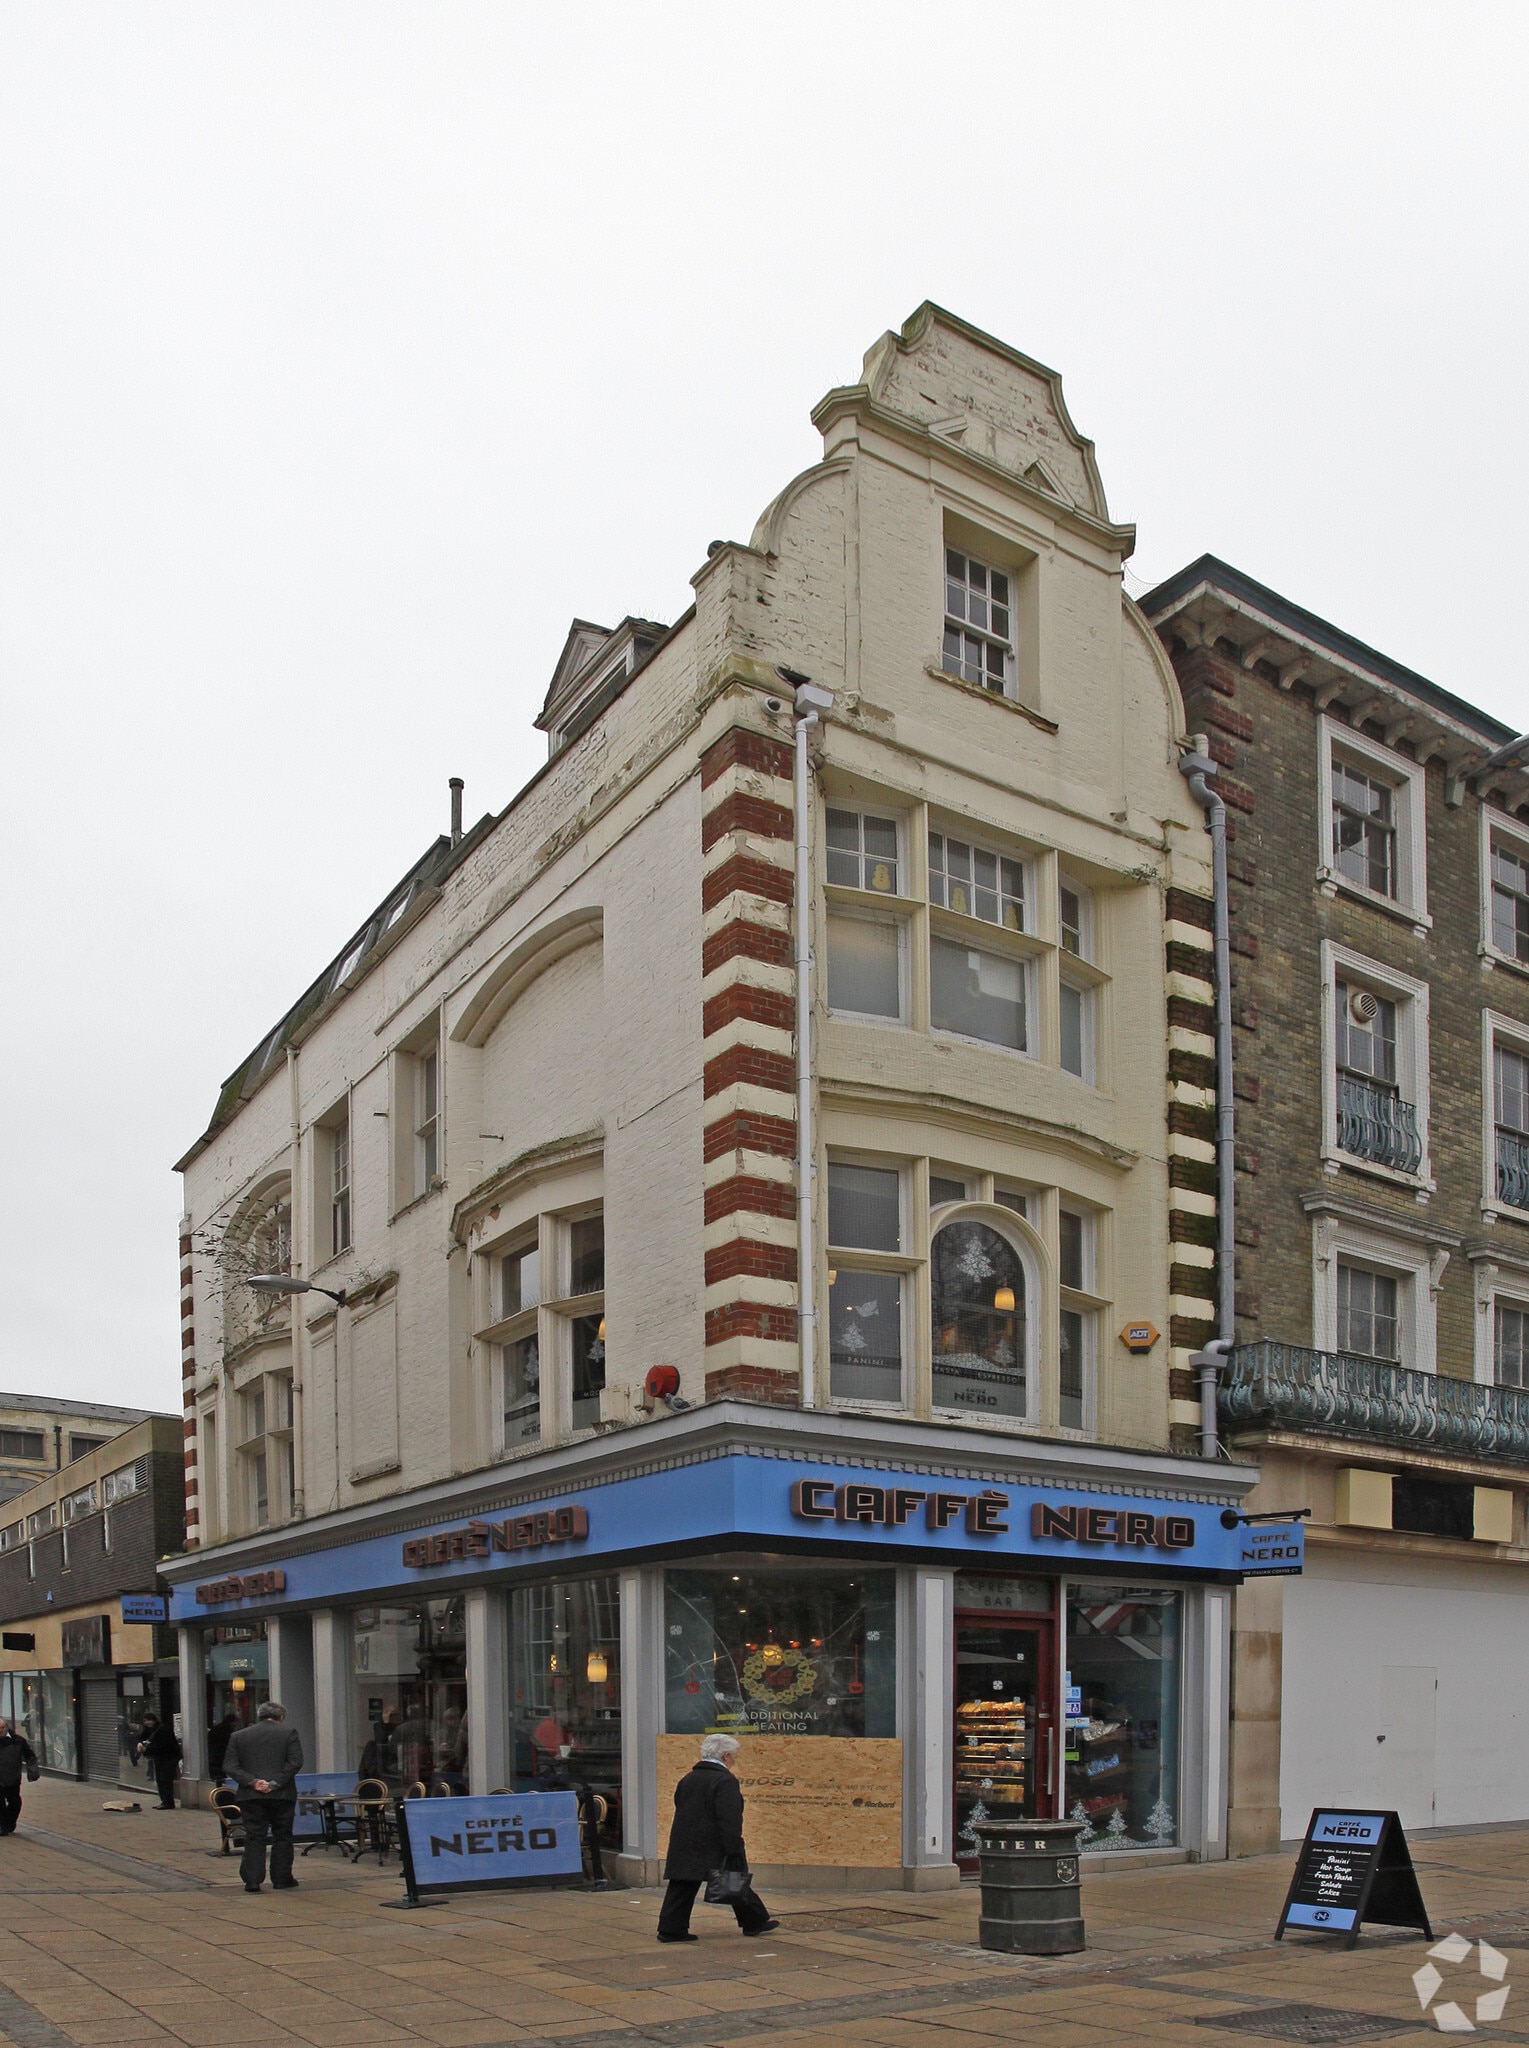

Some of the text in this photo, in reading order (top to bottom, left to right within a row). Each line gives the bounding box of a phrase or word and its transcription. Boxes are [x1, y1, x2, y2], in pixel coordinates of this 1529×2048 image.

[1130, 1330, 1149, 1338] ADT
[847, 1356, 884, 1366] PANINI
[977, 1371, 1018, 1385] ESPRESSO
[953, 1392, 997, 1406] NERO
[792, 1479, 1196, 1548] CAFFÈ NERO
[490, 1505, 588, 1552] NERO
[1241, 1546, 1299, 1561] NERO
[958, 1581, 1038, 1594] ESPRESSO
[984, 1596, 1012, 1607] BAR
[124, 1608, 163, 1617] NERO
[740, 1711, 819, 1720] ADDITIONAL
[1322, 1826, 1372, 1838] NERO
[430, 1827, 557, 1858] NERO
[1327, 1855, 1351, 1864] Panini
[1320, 1863, 1352, 1874] Hot Soup
[1314, 1871, 1353, 1881] Fresh Pasta
[1320, 1880, 1342, 1889] Salads
[1317, 1888, 1340, 1897] Cakes
